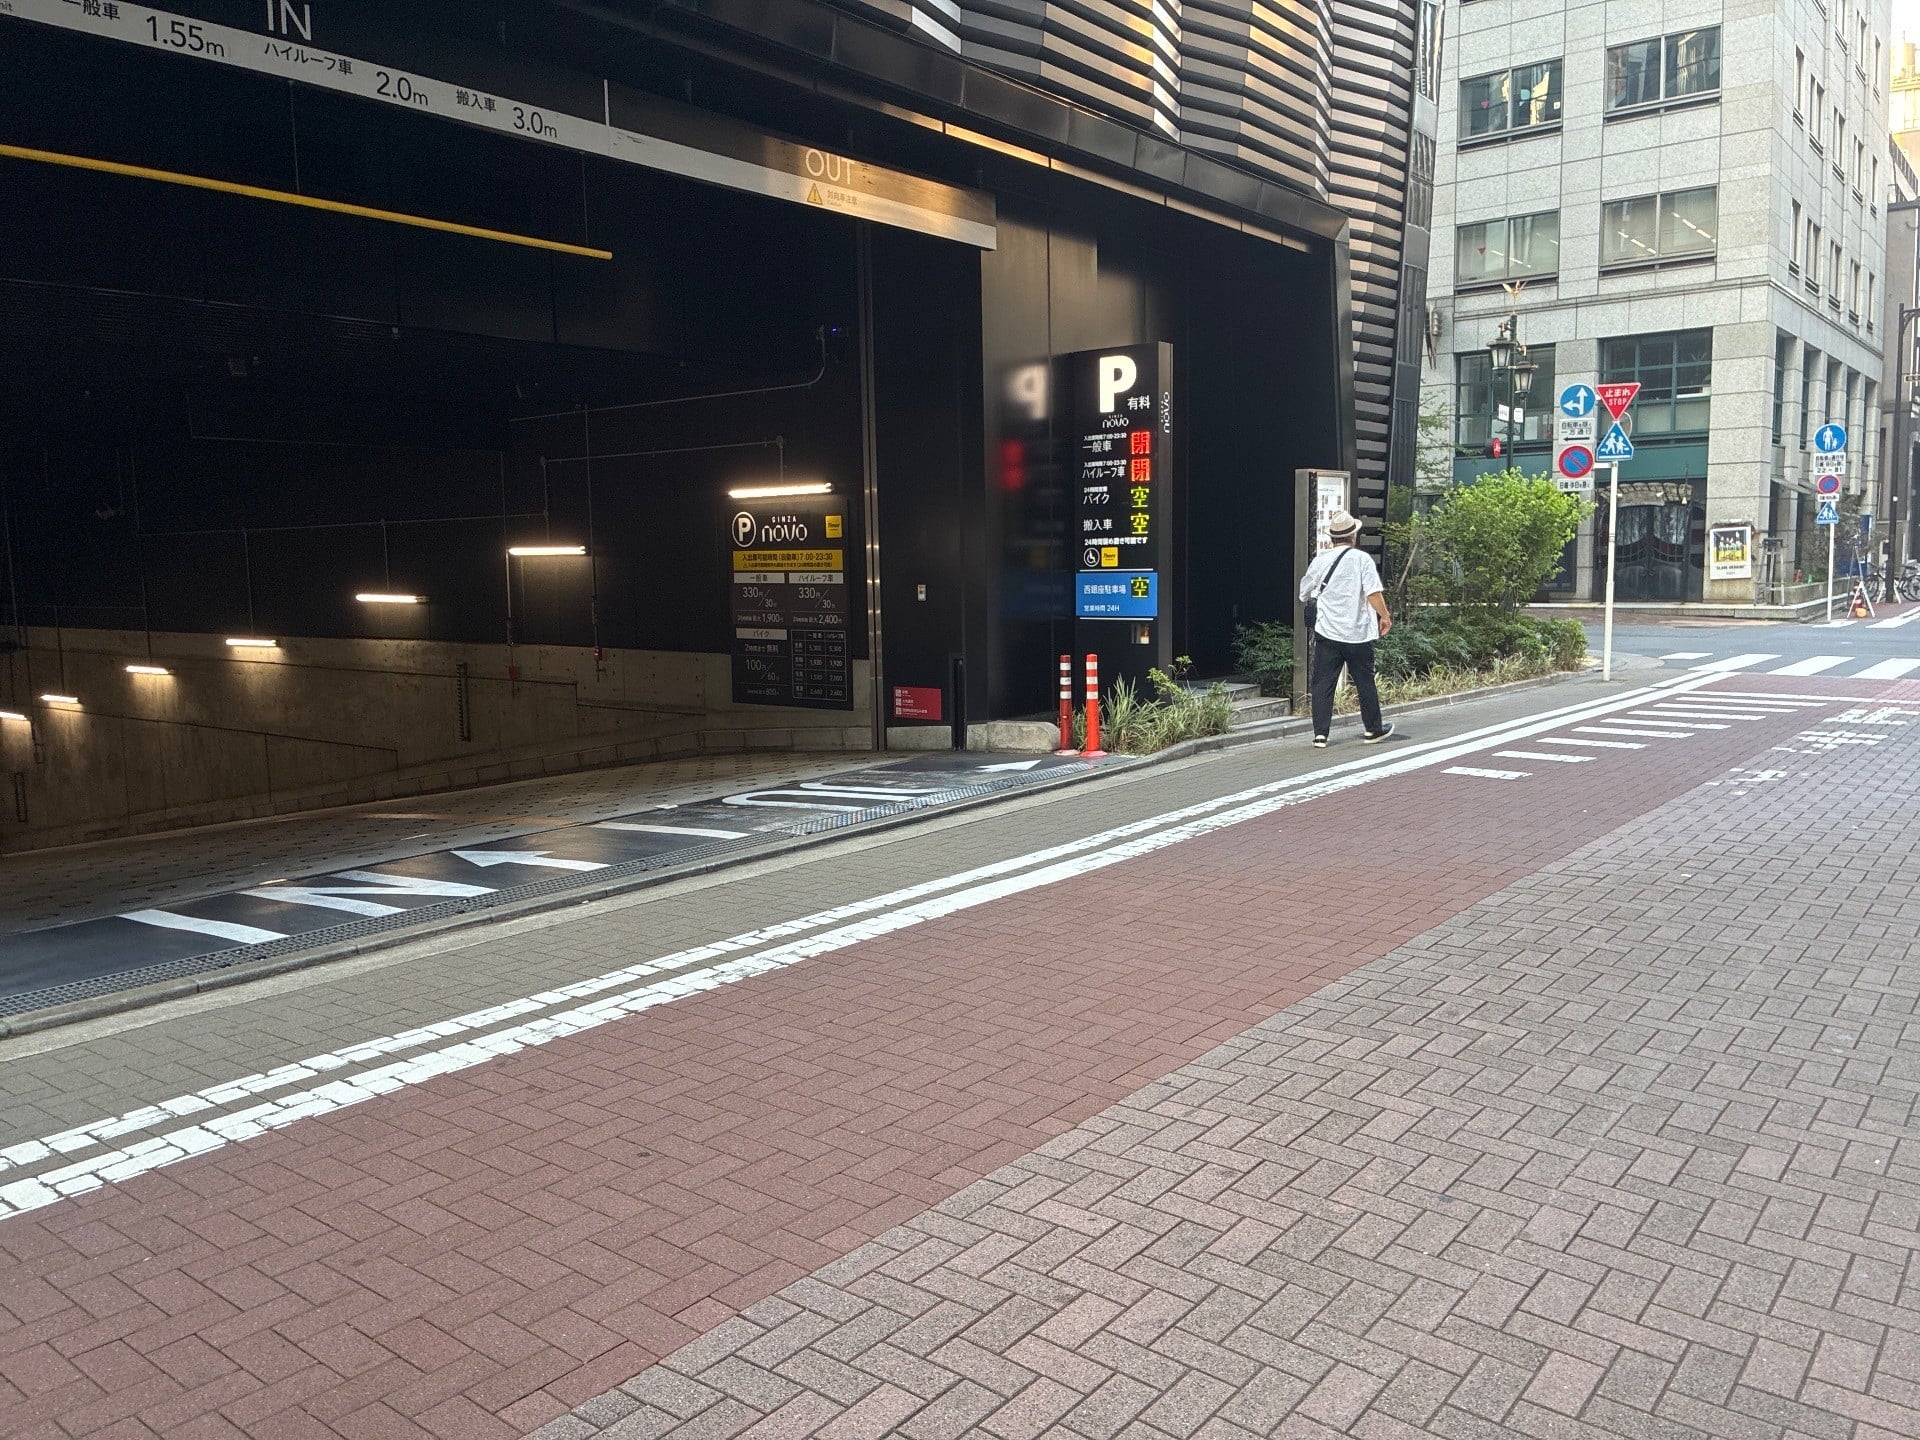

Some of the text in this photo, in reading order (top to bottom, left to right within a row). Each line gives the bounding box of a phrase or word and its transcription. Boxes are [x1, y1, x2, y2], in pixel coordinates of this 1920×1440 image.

[265, 0, 312, 41] IN
[145, 15, 225, 57] 1.55m
[264, 42, 353, 75] ハイルーフ車
[375, 70, 429, 106] 2.0m
[456, 89, 497, 112] 搬入車
[512, 106, 558, 138] 3.0m
[805, 148, 856, 185] OUT
[1099, 355, 1137, 413] P
[1604, 387, 1631, 398] 止まれ
[1127, 395, 1151, 410] 有料
[1608, 397, 1628, 406] STOP
[1082, 440, 1112, 453] 一般車
[1082, 466, 1126, 479] ハイルーフ車
[1083, 492, 1110, 505] バイク
[1130, 486, 1150, 508] 空
[771, 515, 797, 523] GINZA
[1083, 518, 1113, 531] 搬入車
[1130, 512, 1150, 535] 空
[761, 523, 808, 542] novo
[1083, 584, 1126, 595] 西銀座駐車場
[1130, 576, 1150, 598] 空
